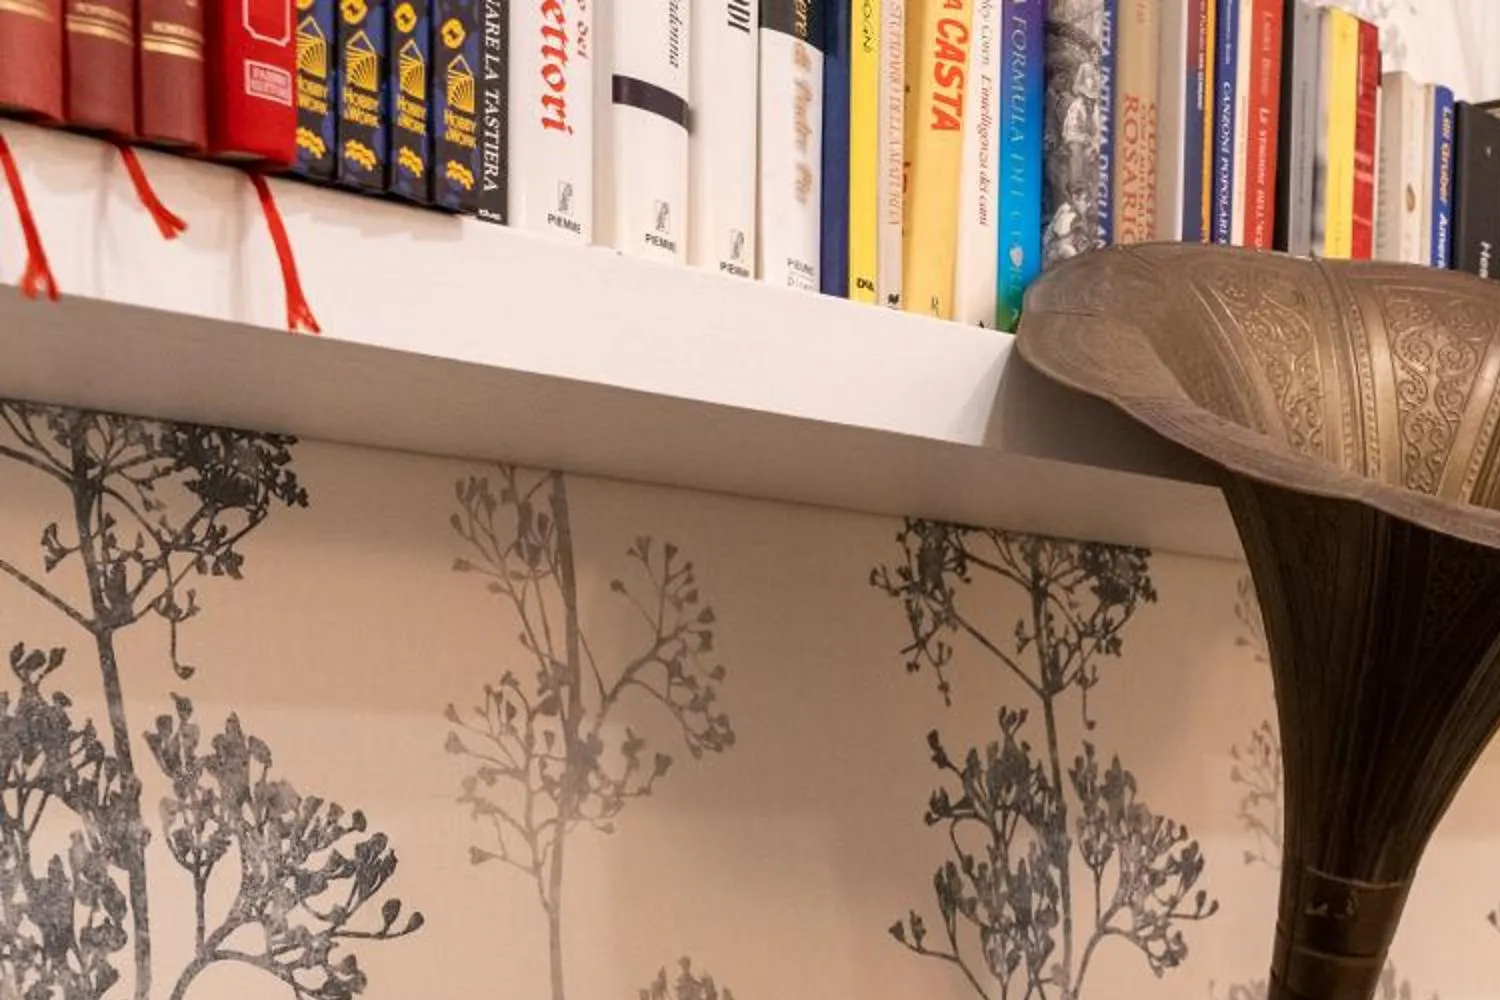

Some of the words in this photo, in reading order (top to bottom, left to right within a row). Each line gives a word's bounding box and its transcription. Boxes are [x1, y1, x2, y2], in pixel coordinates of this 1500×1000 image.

[485, 53, 501, 81] LA
[541, 0, 576, 135] ettori
[667, 0, 688, 68] adonna
[931, 17, 970, 132] CASTA
[1009, 15, 1027, 142] FORMULA
[483, 88, 501, 192] TASTIERA
[1220, 80, 1233, 152] CANZONI
[1218, 156, 1231, 234] POPOLARI
[1439, 144, 1452, 204] Gruber
[1436, 213, 1450, 269] Ameri
